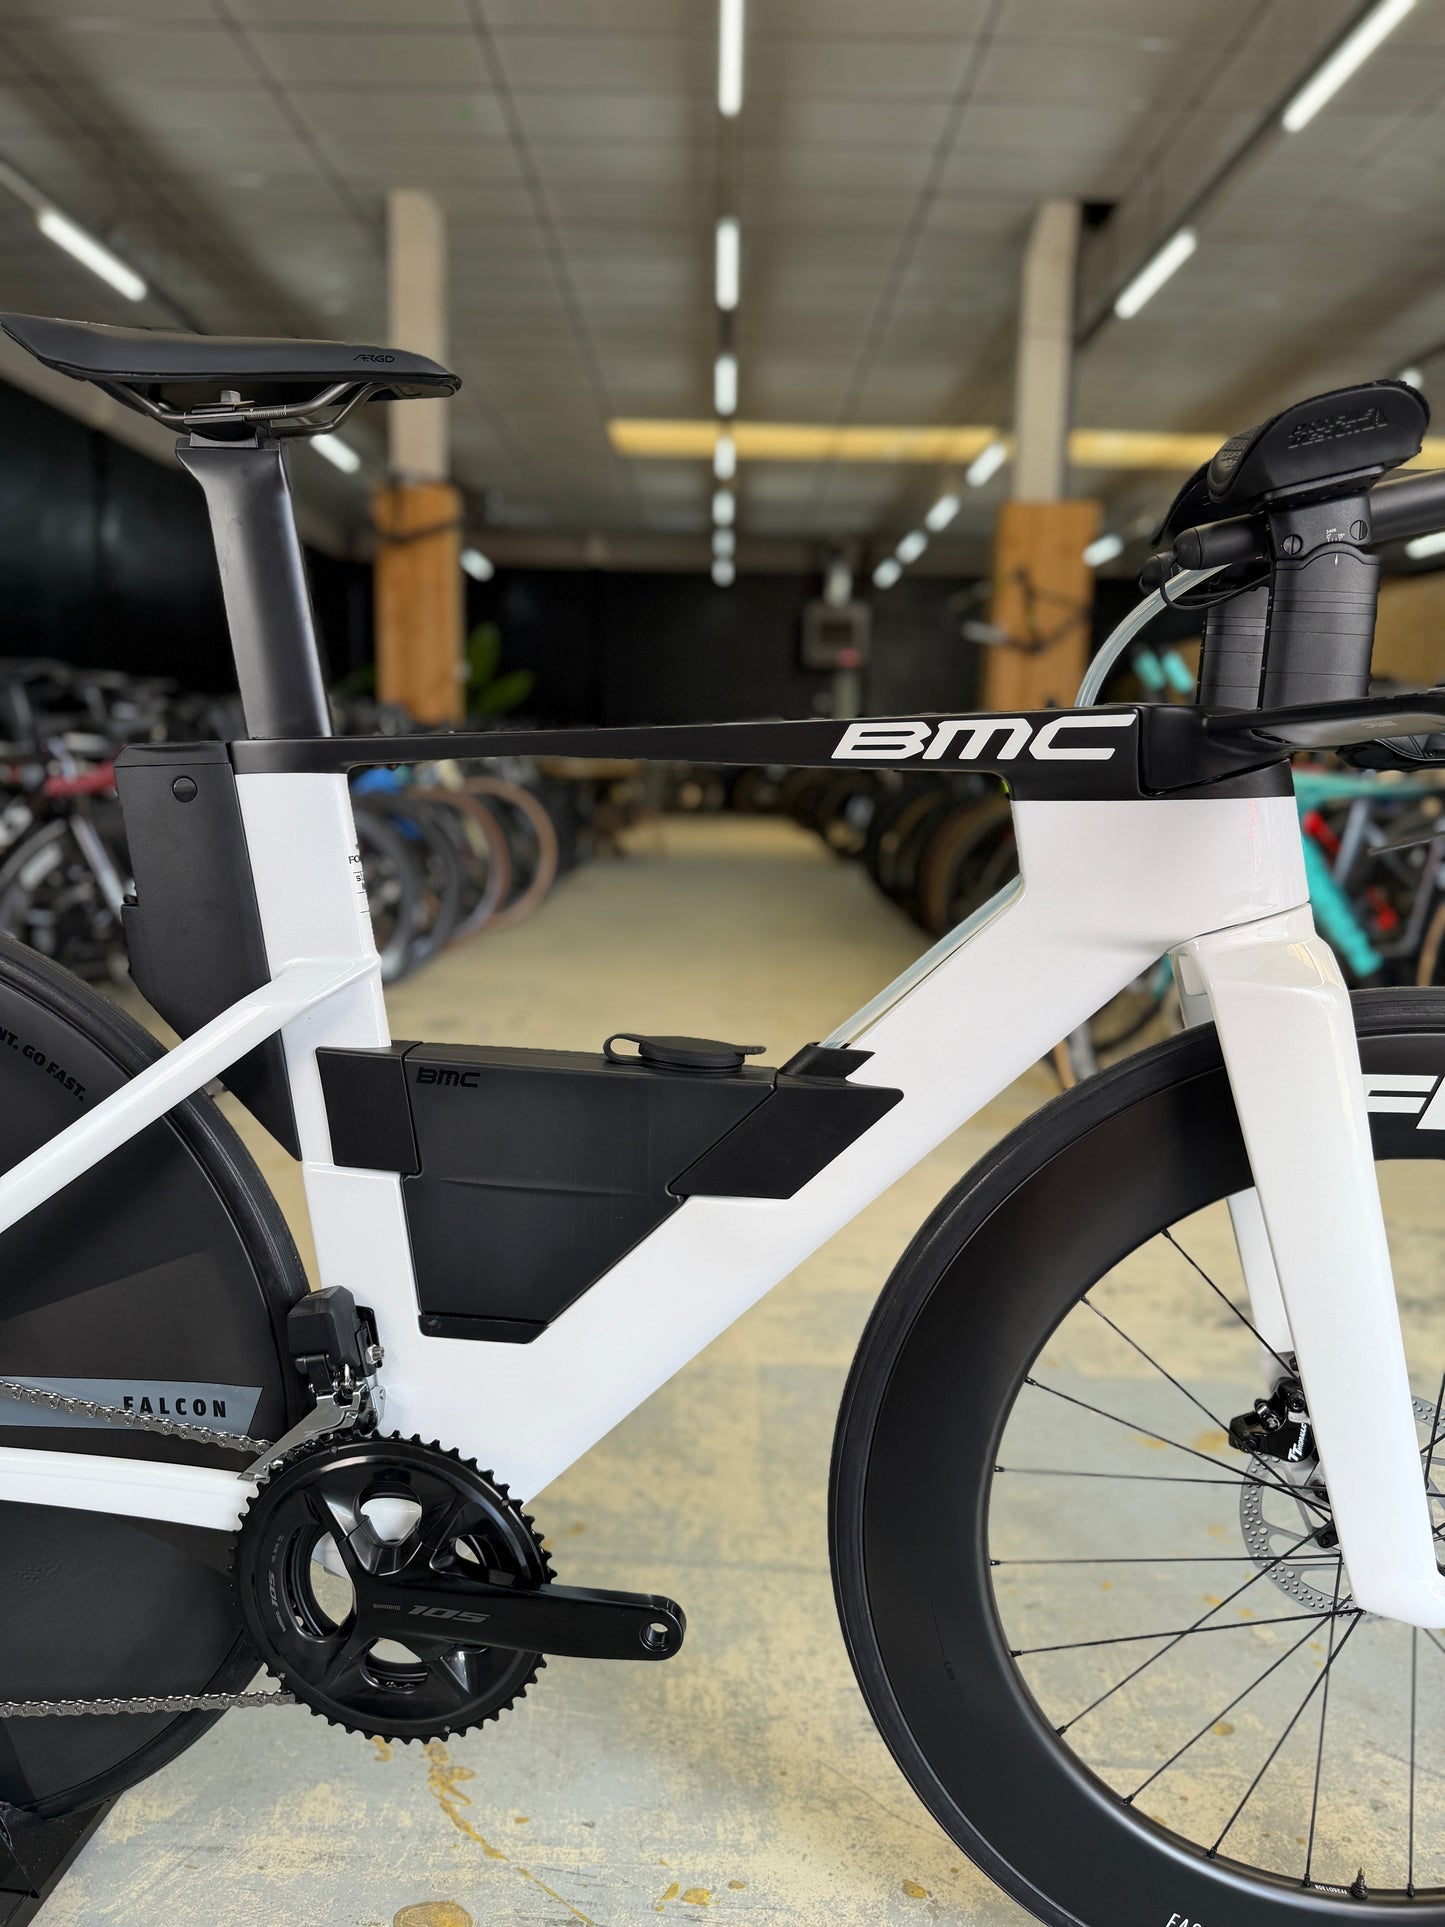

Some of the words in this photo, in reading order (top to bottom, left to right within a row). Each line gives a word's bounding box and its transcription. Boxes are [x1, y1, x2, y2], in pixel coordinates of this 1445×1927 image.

[353, 354, 395, 363] ARGO
[831, 713, 1137, 761] BMC
[22, 1044, 46, 1066] GO
[46, 1061, 87, 1101] FAST.
[415, 1066, 481, 1088] BMC
[123, 1396, 227, 1418] FALCON
[268, 1569, 278, 1607] 105
[407, 1604, 491, 1623] 105
